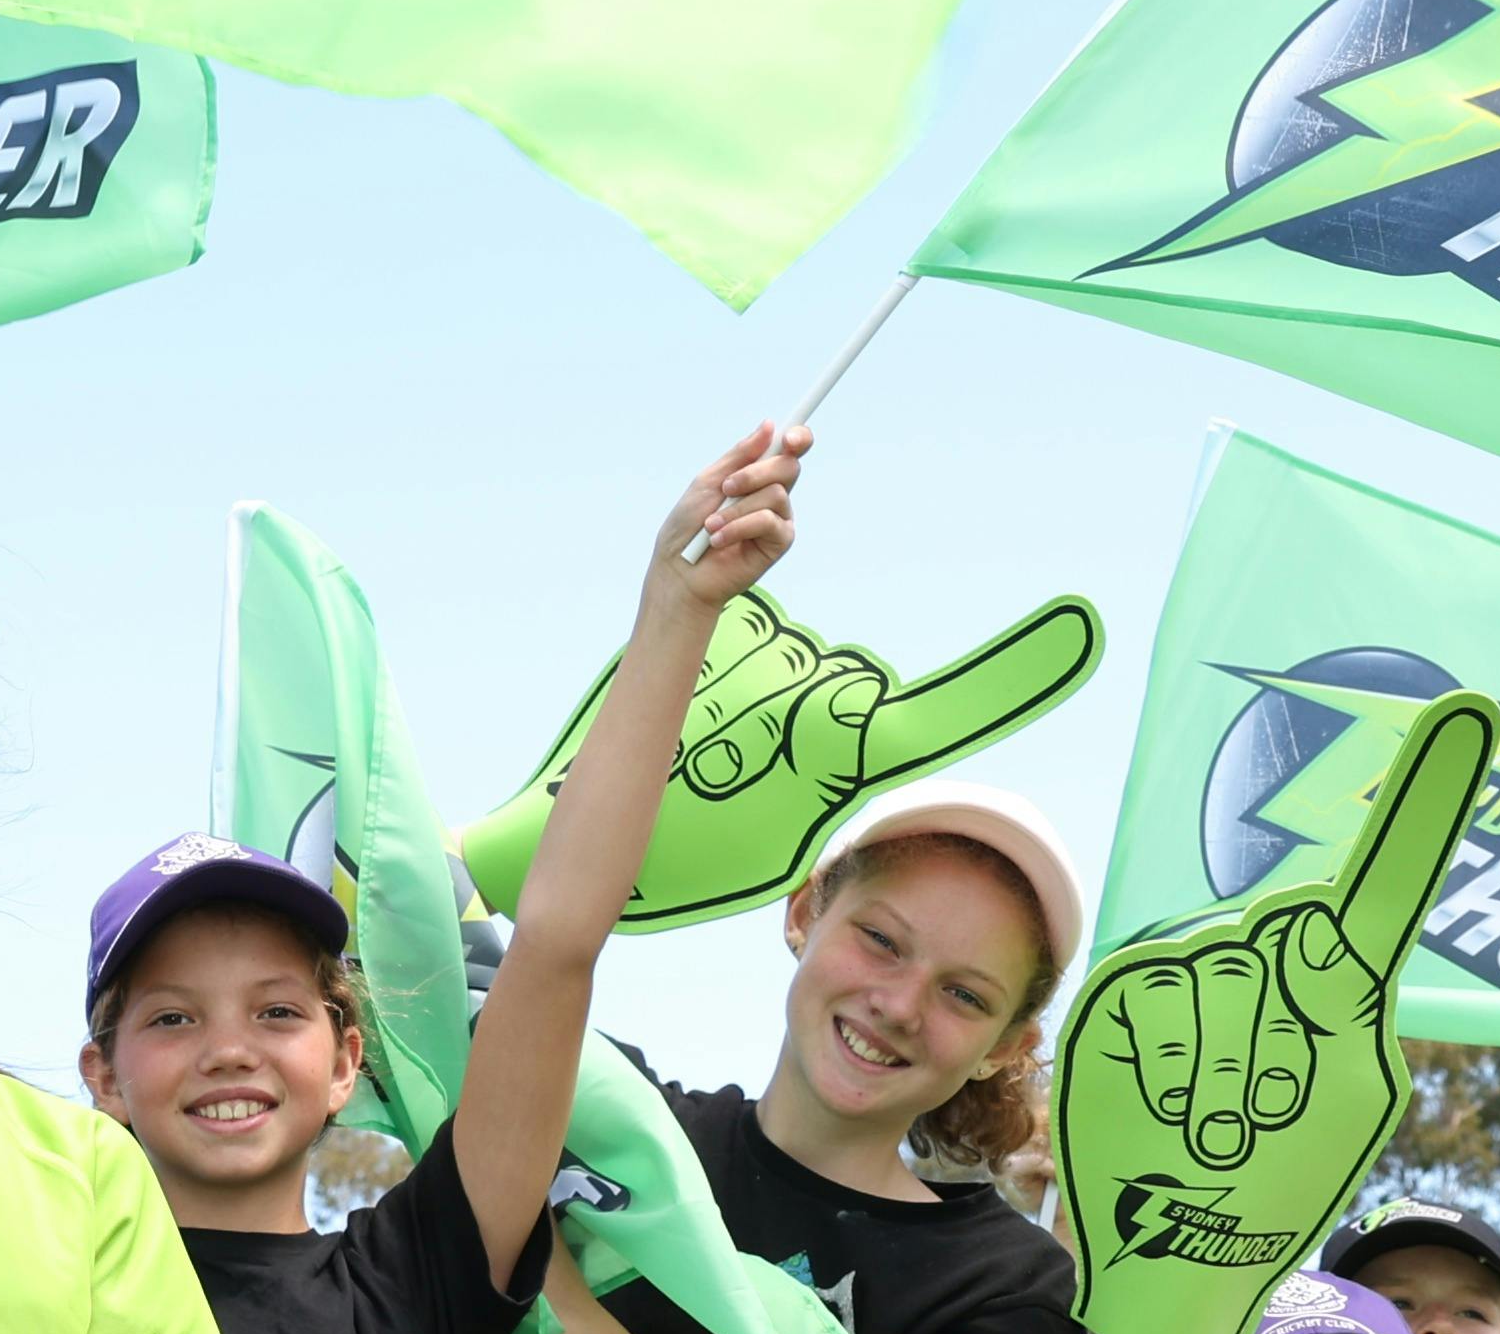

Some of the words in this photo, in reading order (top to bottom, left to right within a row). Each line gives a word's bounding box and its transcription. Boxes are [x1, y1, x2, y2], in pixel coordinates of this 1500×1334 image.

[1170, 1206, 1236, 1231] SYDNEY
[1167, 1224, 1291, 1264] THUNDER
[1325, 1318, 1356, 1331] CLUB
